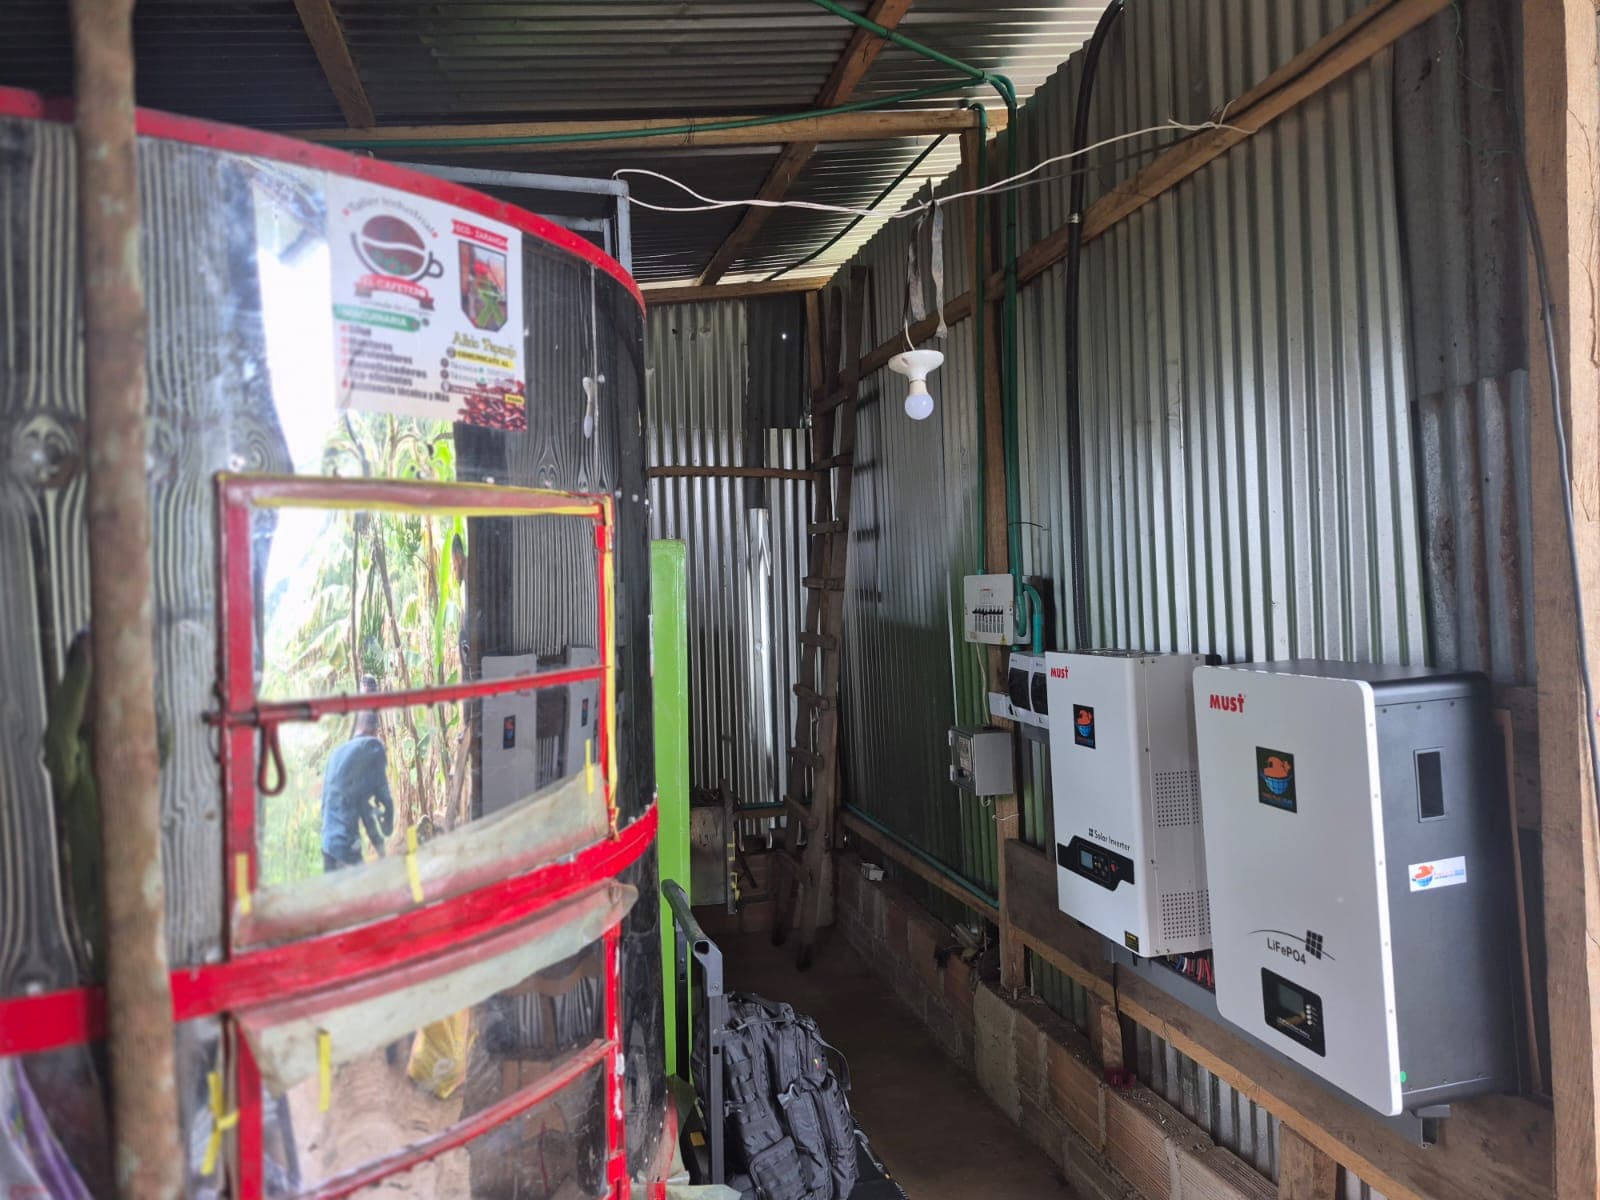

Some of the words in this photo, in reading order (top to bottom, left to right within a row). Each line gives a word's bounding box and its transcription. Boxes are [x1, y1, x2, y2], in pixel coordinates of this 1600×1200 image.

[1050, 666, 1069, 679] MUST
[1209, 693, 1245, 713] MUST
[1094, 829, 1108, 843] Solar
[1108, 836, 1131, 852] Inverter
[1266, 937, 1306, 965] LiFePO4
